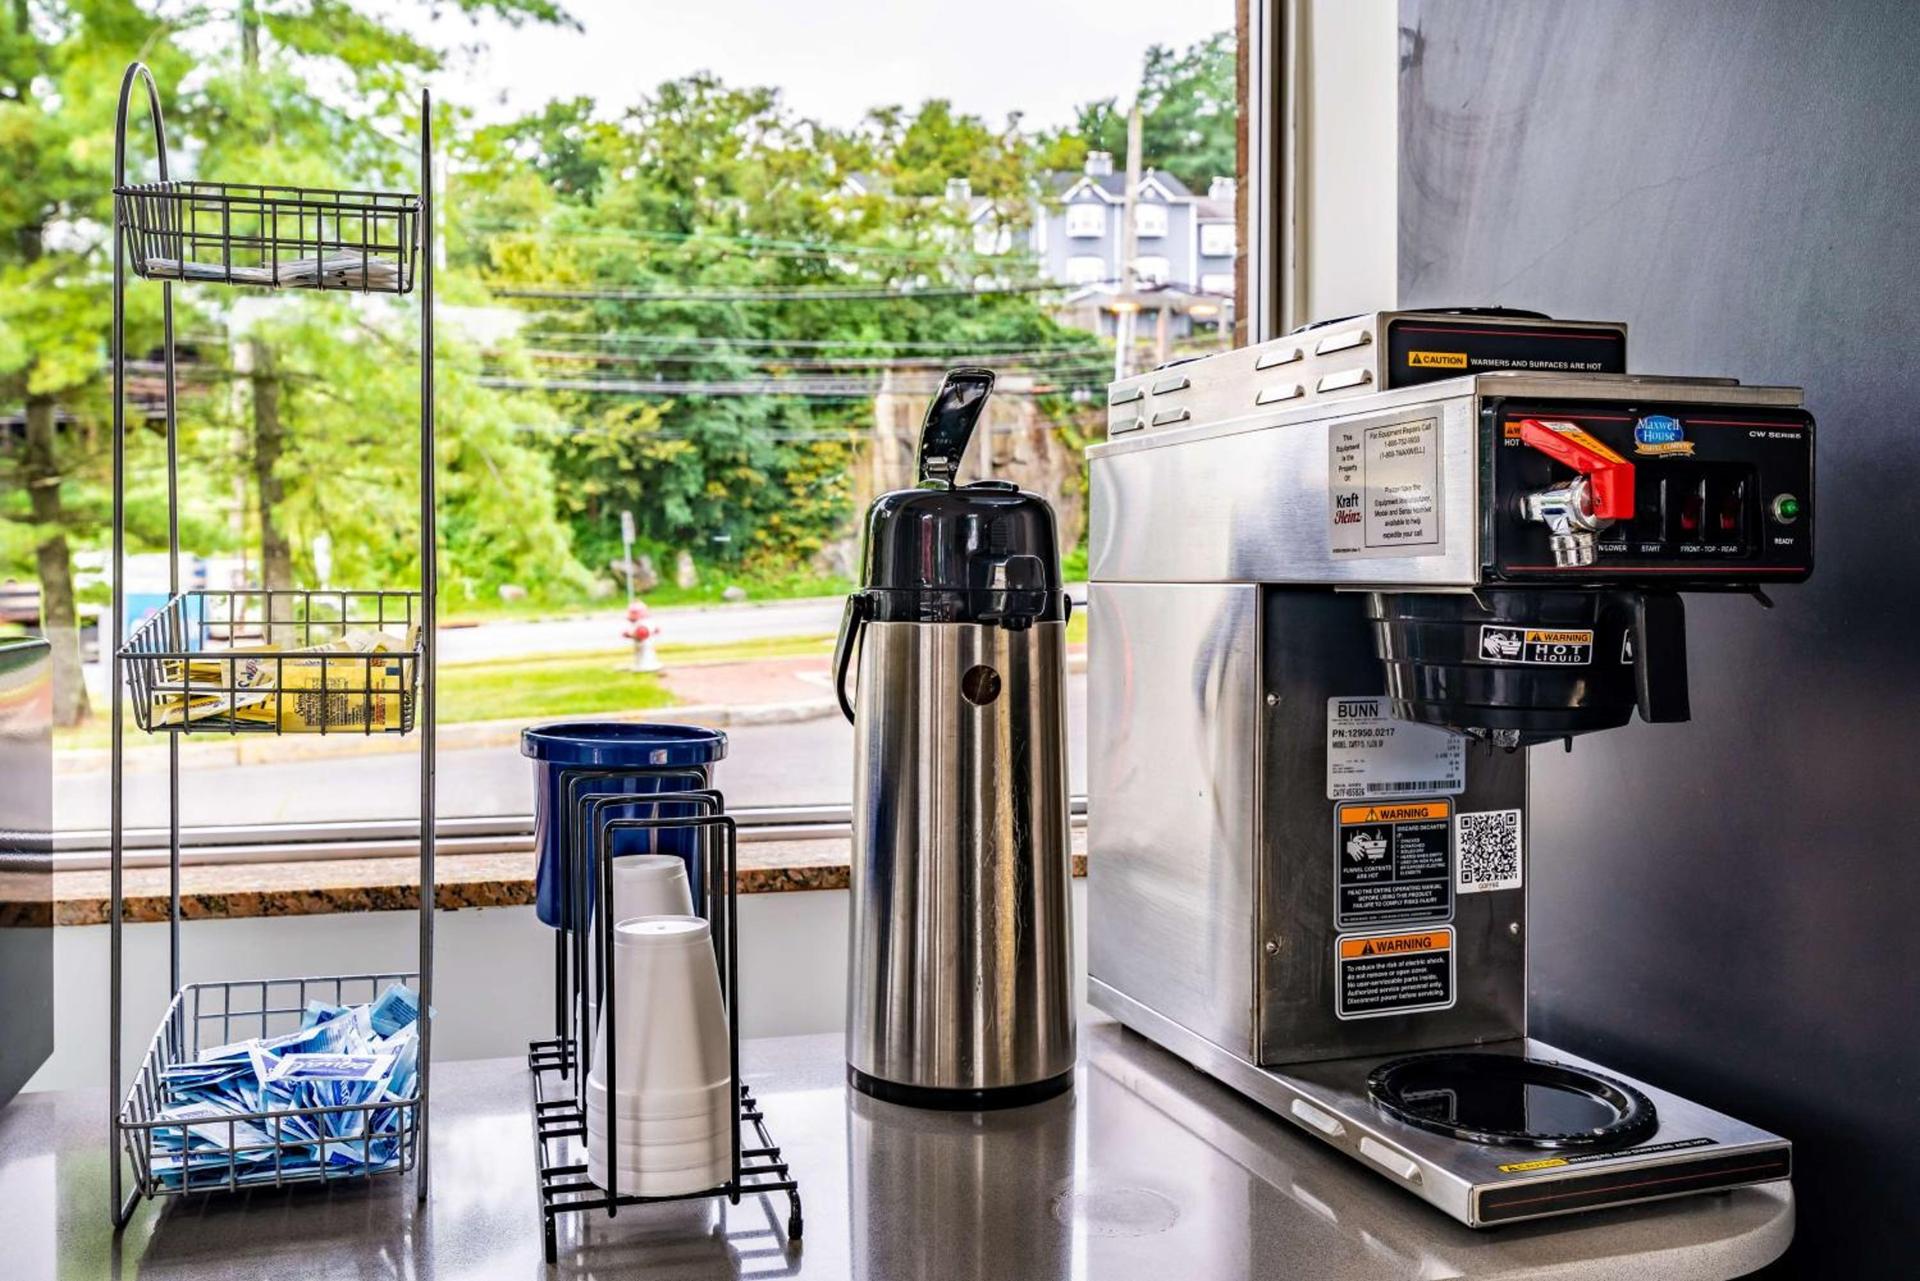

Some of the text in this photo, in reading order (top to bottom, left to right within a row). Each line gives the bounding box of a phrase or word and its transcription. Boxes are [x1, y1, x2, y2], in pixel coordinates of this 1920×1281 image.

[1423, 356, 1463, 364] CAUTION
[1471, 359, 1509, 367] WARMERS
[1512, 360, 1528, 368] AND
[1530, 360, 1568, 368] SURFACES
[1638, 418, 1679, 430] Maxwell
[1643, 430, 1675, 441] House
[1770, 431, 1801, 439] SERIES
[1336, 493, 1359, 508] Kraft
[1334, 509, 1362, 524] Heinz
[1536, 645, 1582, 654] HOT
[1338, 703, 1378, 718] BUNN
[1380, 808, 1428, 820] WARNING
[1376, 937, 1432, 952] WARNING
[1347, 988, 1378, 996] Authorized
[1401, 983, 1428, 991] personnel
[1347, 996, 1379, 1005] Disconnect
